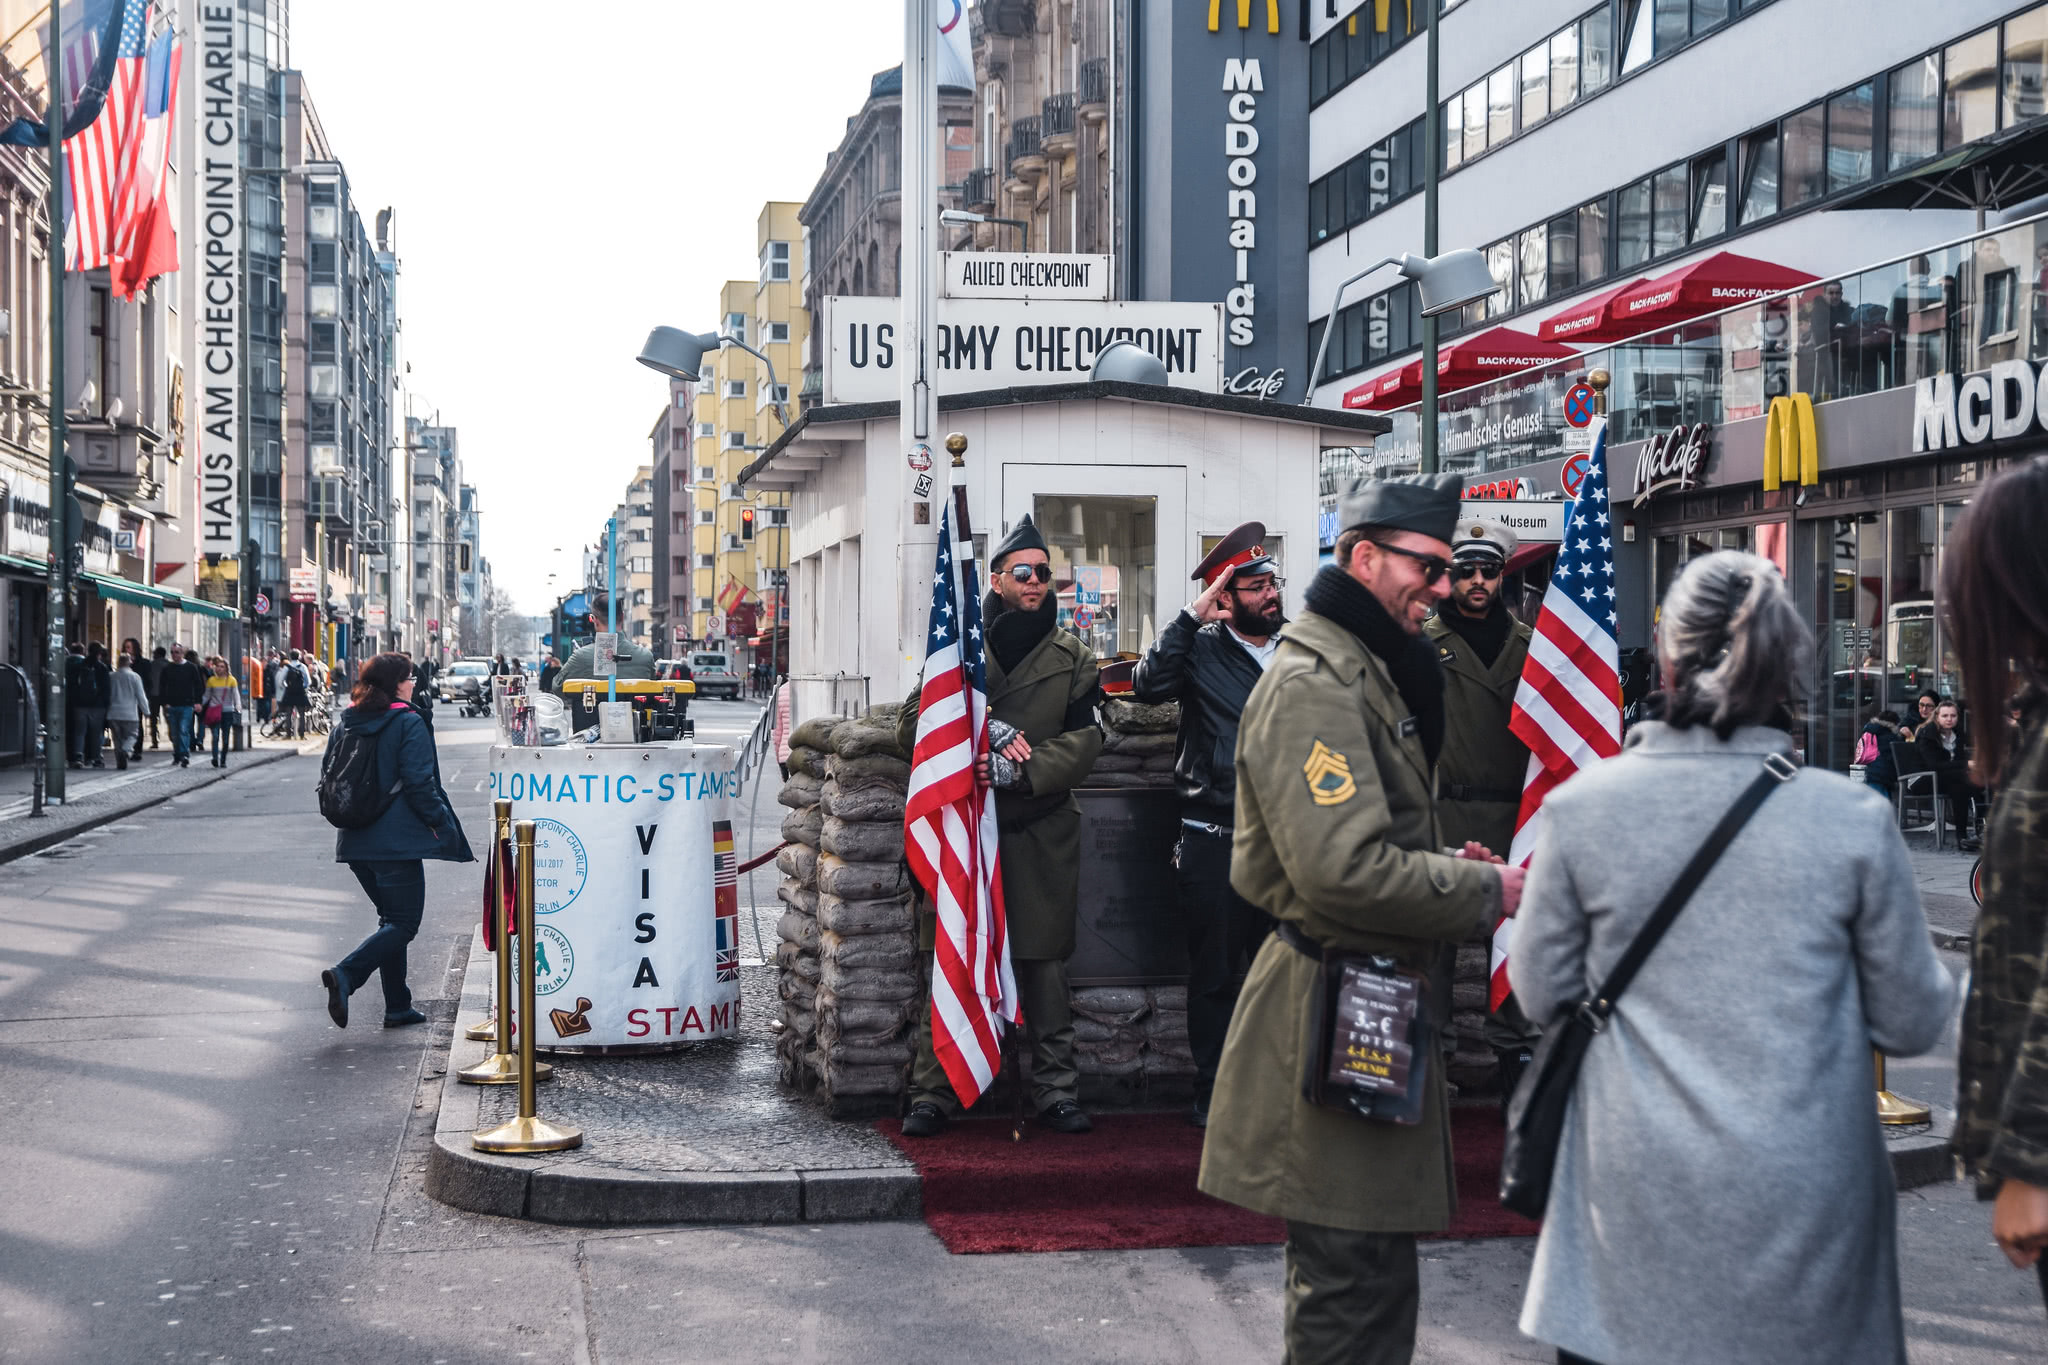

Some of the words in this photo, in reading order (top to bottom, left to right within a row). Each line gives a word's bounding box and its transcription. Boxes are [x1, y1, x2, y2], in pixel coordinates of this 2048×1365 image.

[205, 6, 234, 146] CHARLIE
[205, 157, 234, 375] CHECKPOINT
[963, 261, 1005, 286] ALLIED
[1011, 262, 1092, 288] CHECKPOINT
[849, 323, 894, 369] US
[937, 325, 1000, 371] RMY
[1016, 326, 1202, 373] CHECKOINT
[205, 387, 233, 443] AM
[1445, 418, 1502, 453] Himmlischer
[1633, 422, 1703, 500] McCafé
[204, 453, 234, 542] HAUS
[1501, 514, 1547, 528] Museum
[536, 859, 548, 868] ULI
[548, 859, 564, 869] 2017
[566, 835, 585, 877] CHARLIE
[534, 879, 558, 888] ECTOR
[534, 900, 560, 912] ERLIN
[632, 824, 660, 988] VISA
[543, 928, 571, 964] CHARLIE
[537, 976, 564, 992] ERLIN
[1369, 999, 1399, 1013] PERSON
